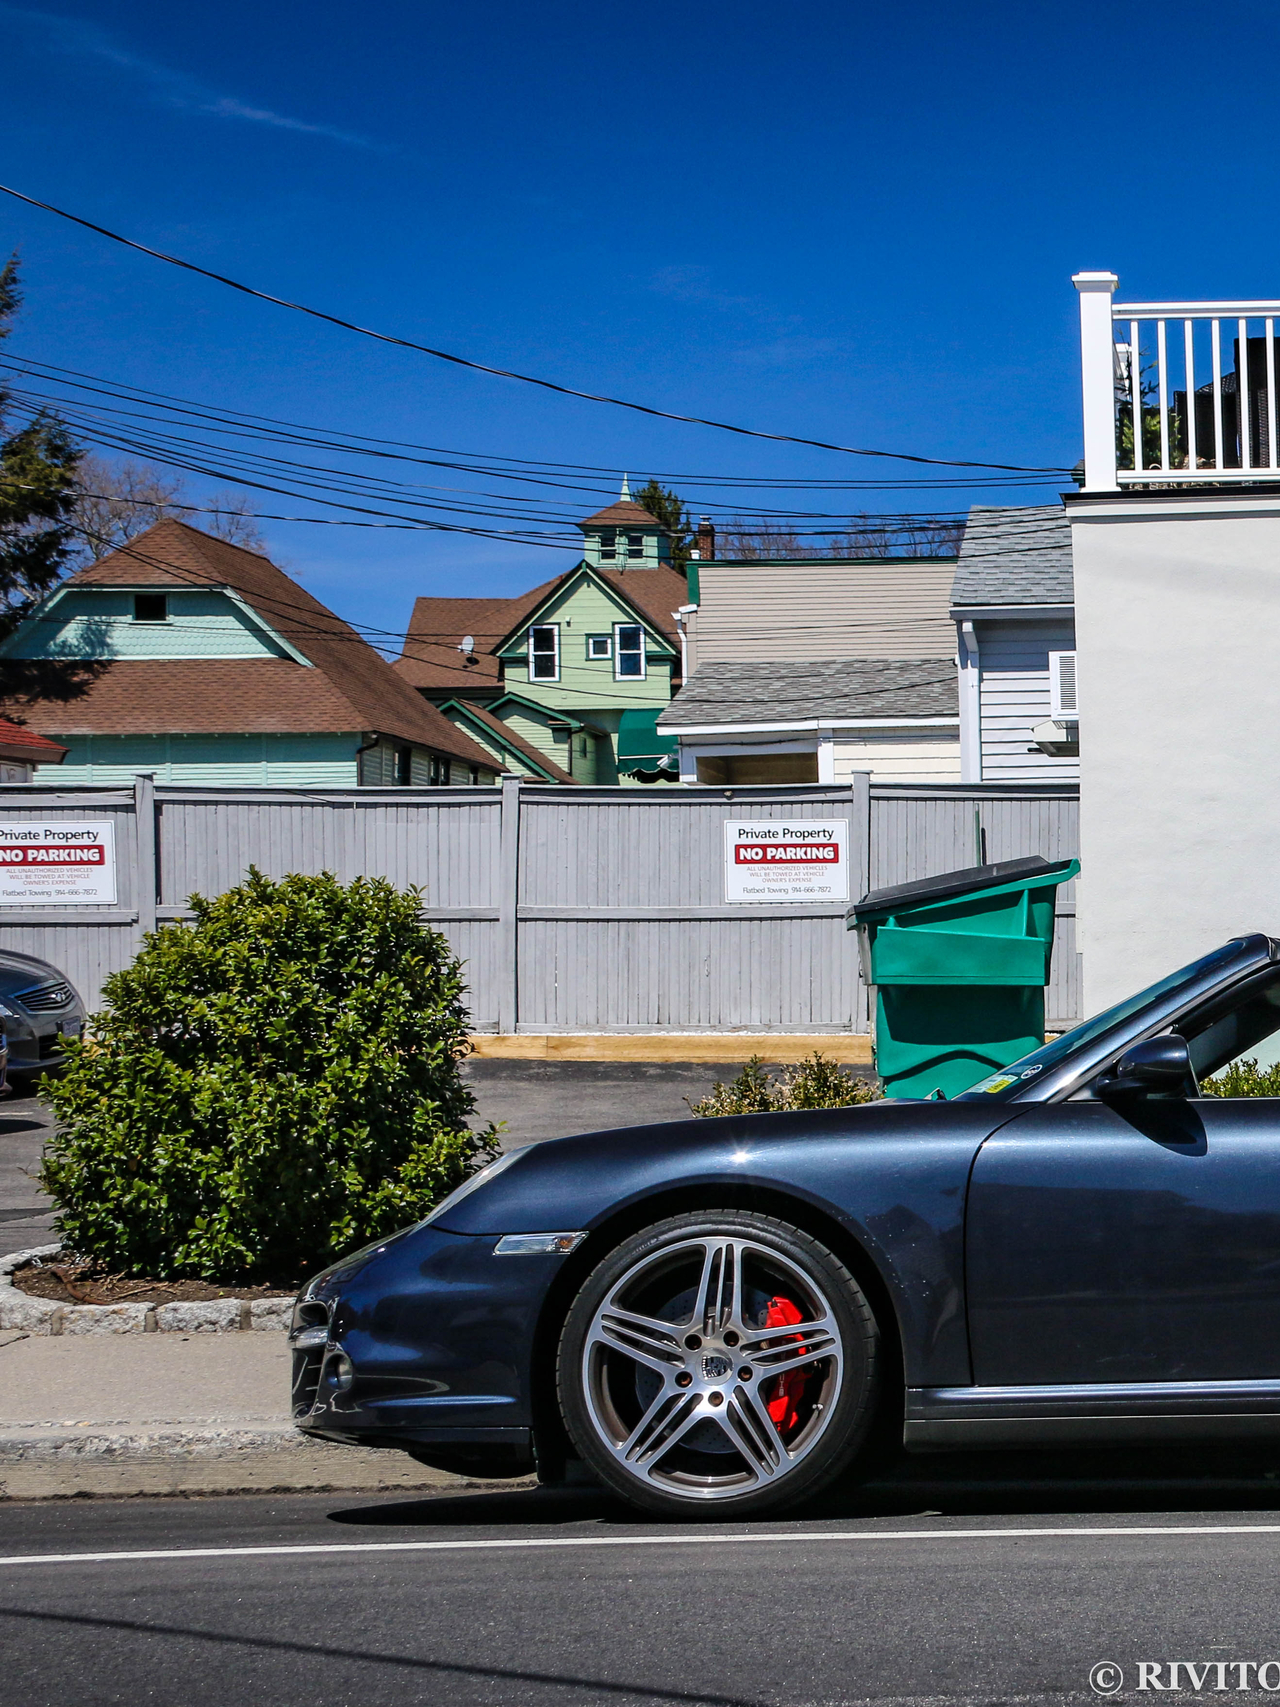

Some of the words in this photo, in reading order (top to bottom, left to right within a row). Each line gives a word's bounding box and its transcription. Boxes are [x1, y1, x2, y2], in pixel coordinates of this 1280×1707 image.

[44, 829, 99, 843] Property
[738, 828, 779, 839] Private
[782, 828, 834, 841] Property
[0, 849, 24, 862] NO
[27, 848, 100, 862] PARKING
[739, 847, 763, 860] NO
[766, 846, 835, 860] PARKING
[28, 889, 52, 897] Towing
[766, 887, 788, 895] Towing
